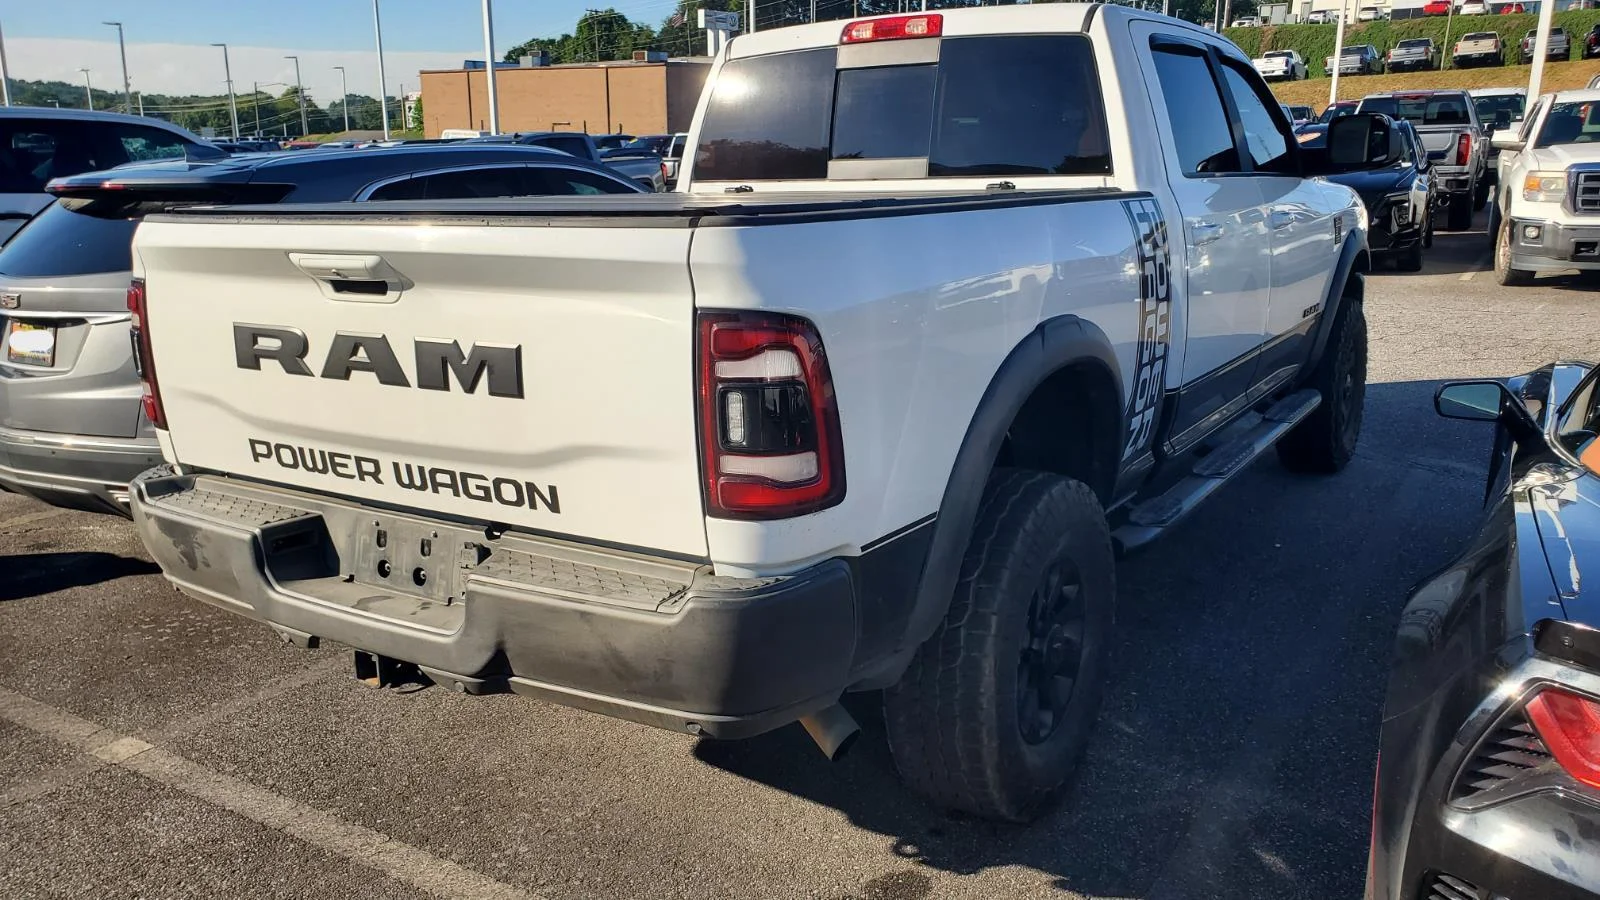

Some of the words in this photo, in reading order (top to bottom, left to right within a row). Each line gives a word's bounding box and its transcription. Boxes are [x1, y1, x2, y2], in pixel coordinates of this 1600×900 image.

[233, 321, 525, 400] RAM
[248, 438, 384, 485] POWER
[392, 461, 561, 514] WAGON
